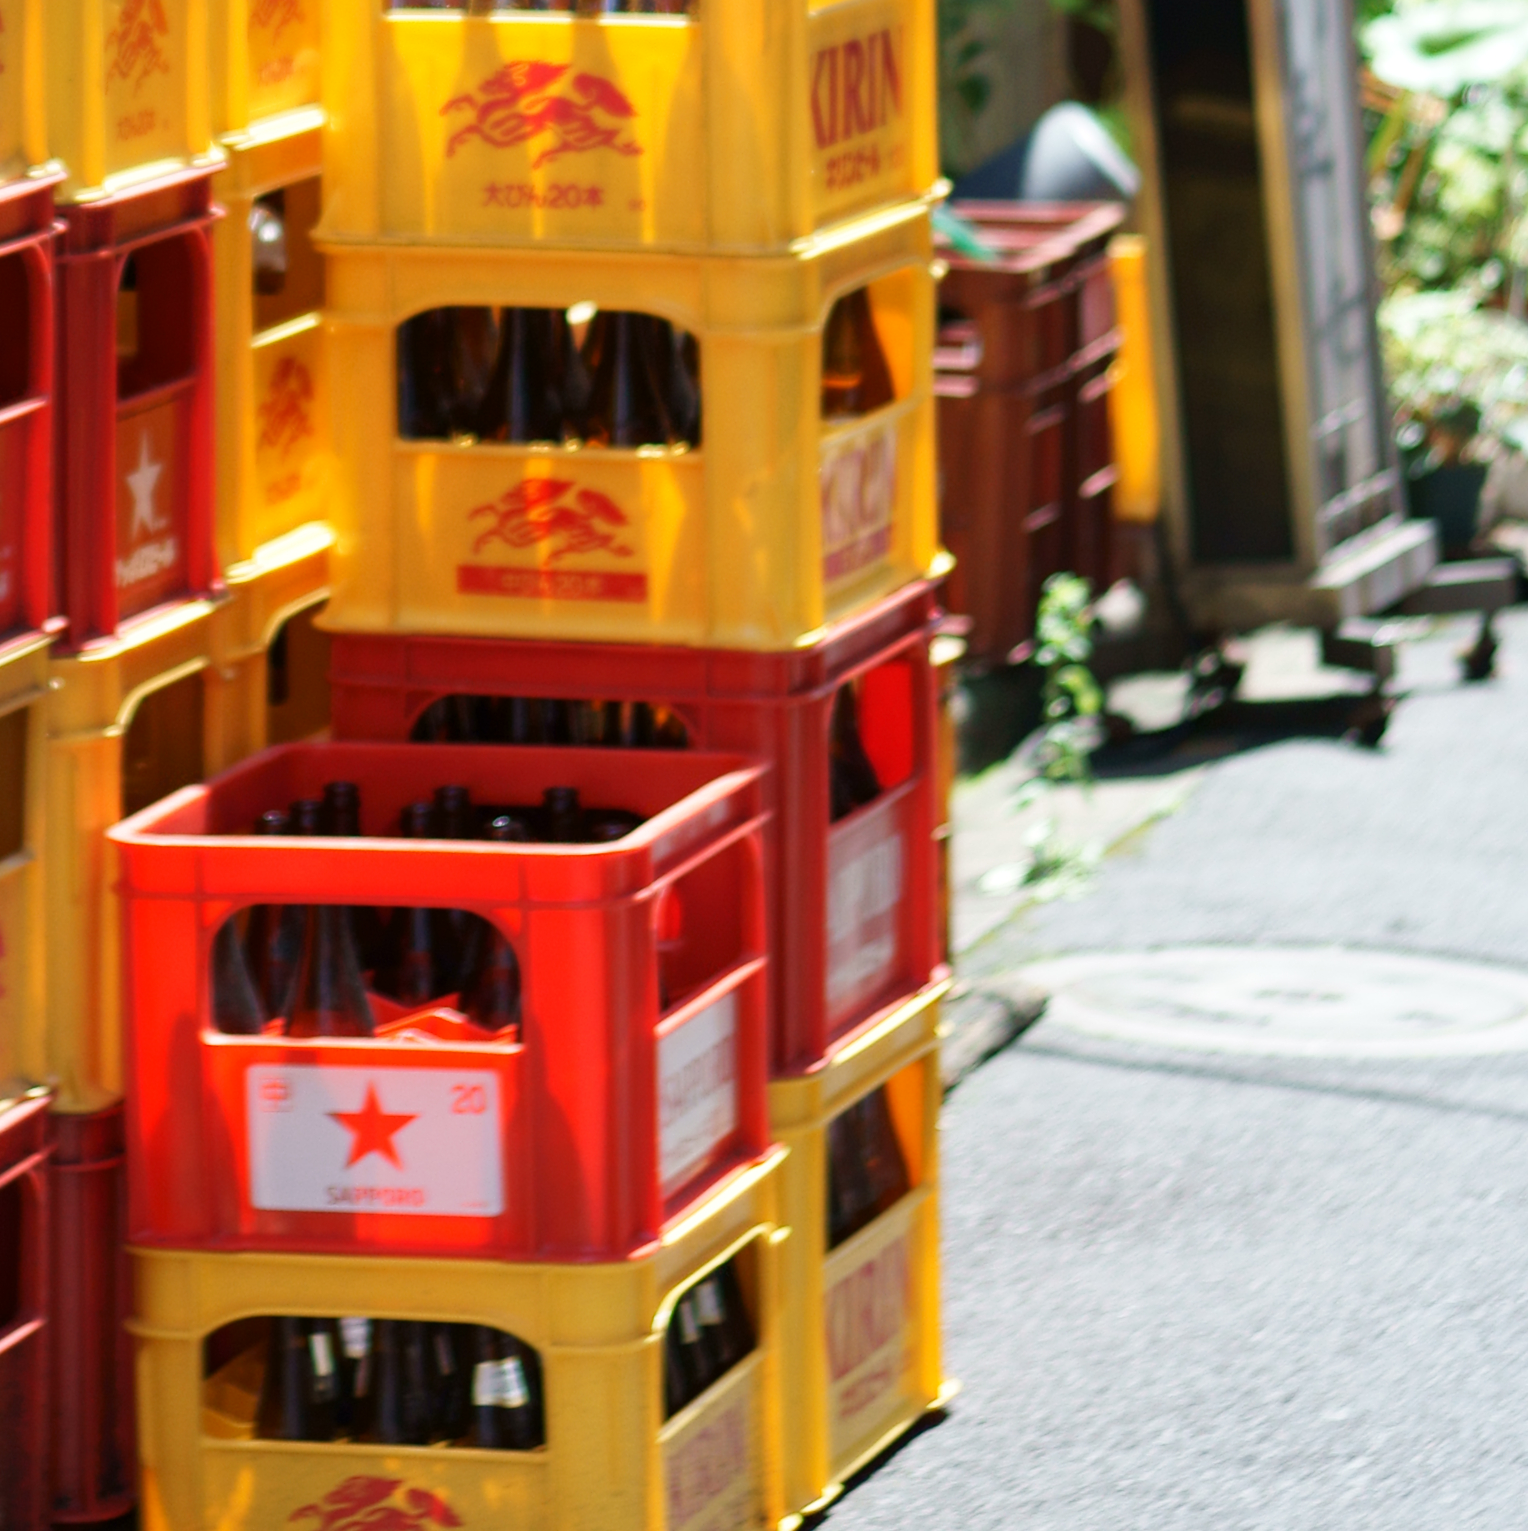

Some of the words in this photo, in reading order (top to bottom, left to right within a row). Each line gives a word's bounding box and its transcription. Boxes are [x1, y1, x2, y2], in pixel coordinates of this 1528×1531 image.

[482, 182, 604, 211] 大びん20本
[451, 1085, 486, 1113] 20
[327, 1186, 423, 1208] SAPPORO
